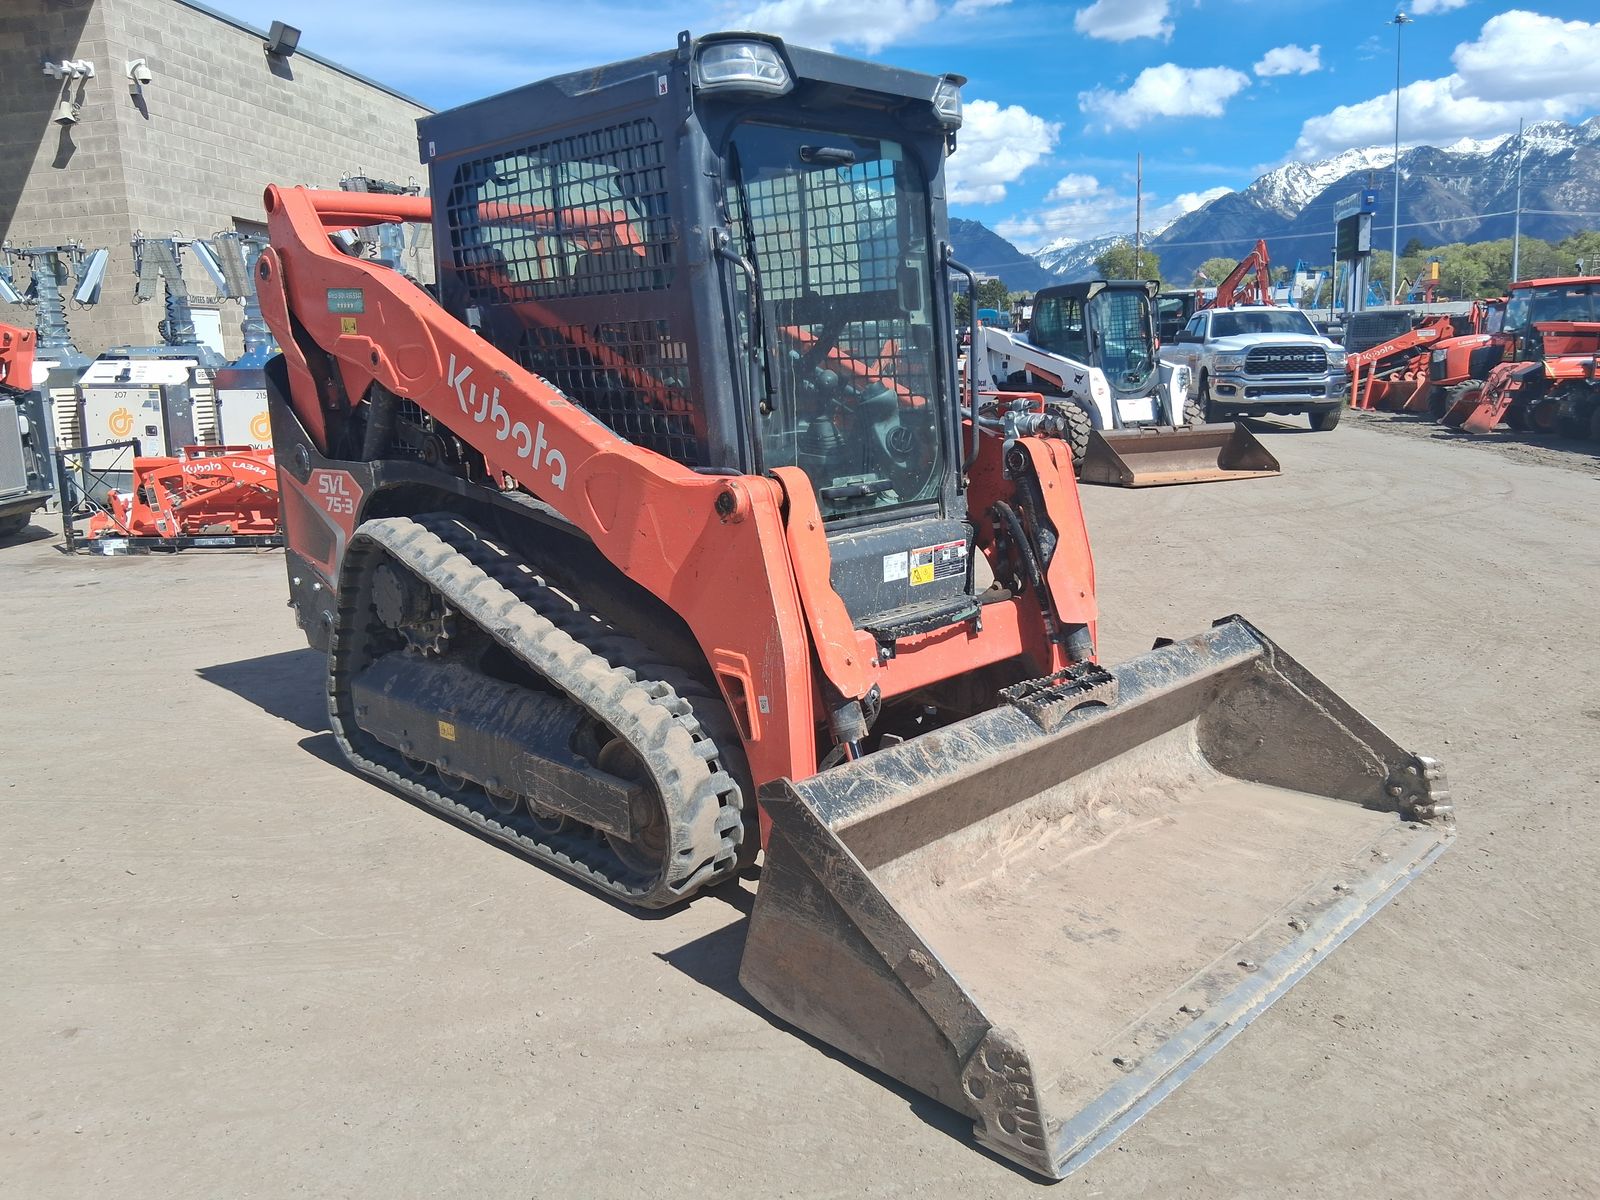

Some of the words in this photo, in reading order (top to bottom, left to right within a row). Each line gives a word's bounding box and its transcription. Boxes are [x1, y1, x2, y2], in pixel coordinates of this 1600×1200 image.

[1362, 345, 1394, 360] Kubota
[114, 391, 127, 399] 207
[447, 353, 567, 491] Kubota
[182, 461, 222, 475] Kubota
[232, 461, 267, 476] LA344
[318, 474, 350, 496] SVL
[325, 496, 353, 514] 75-3
